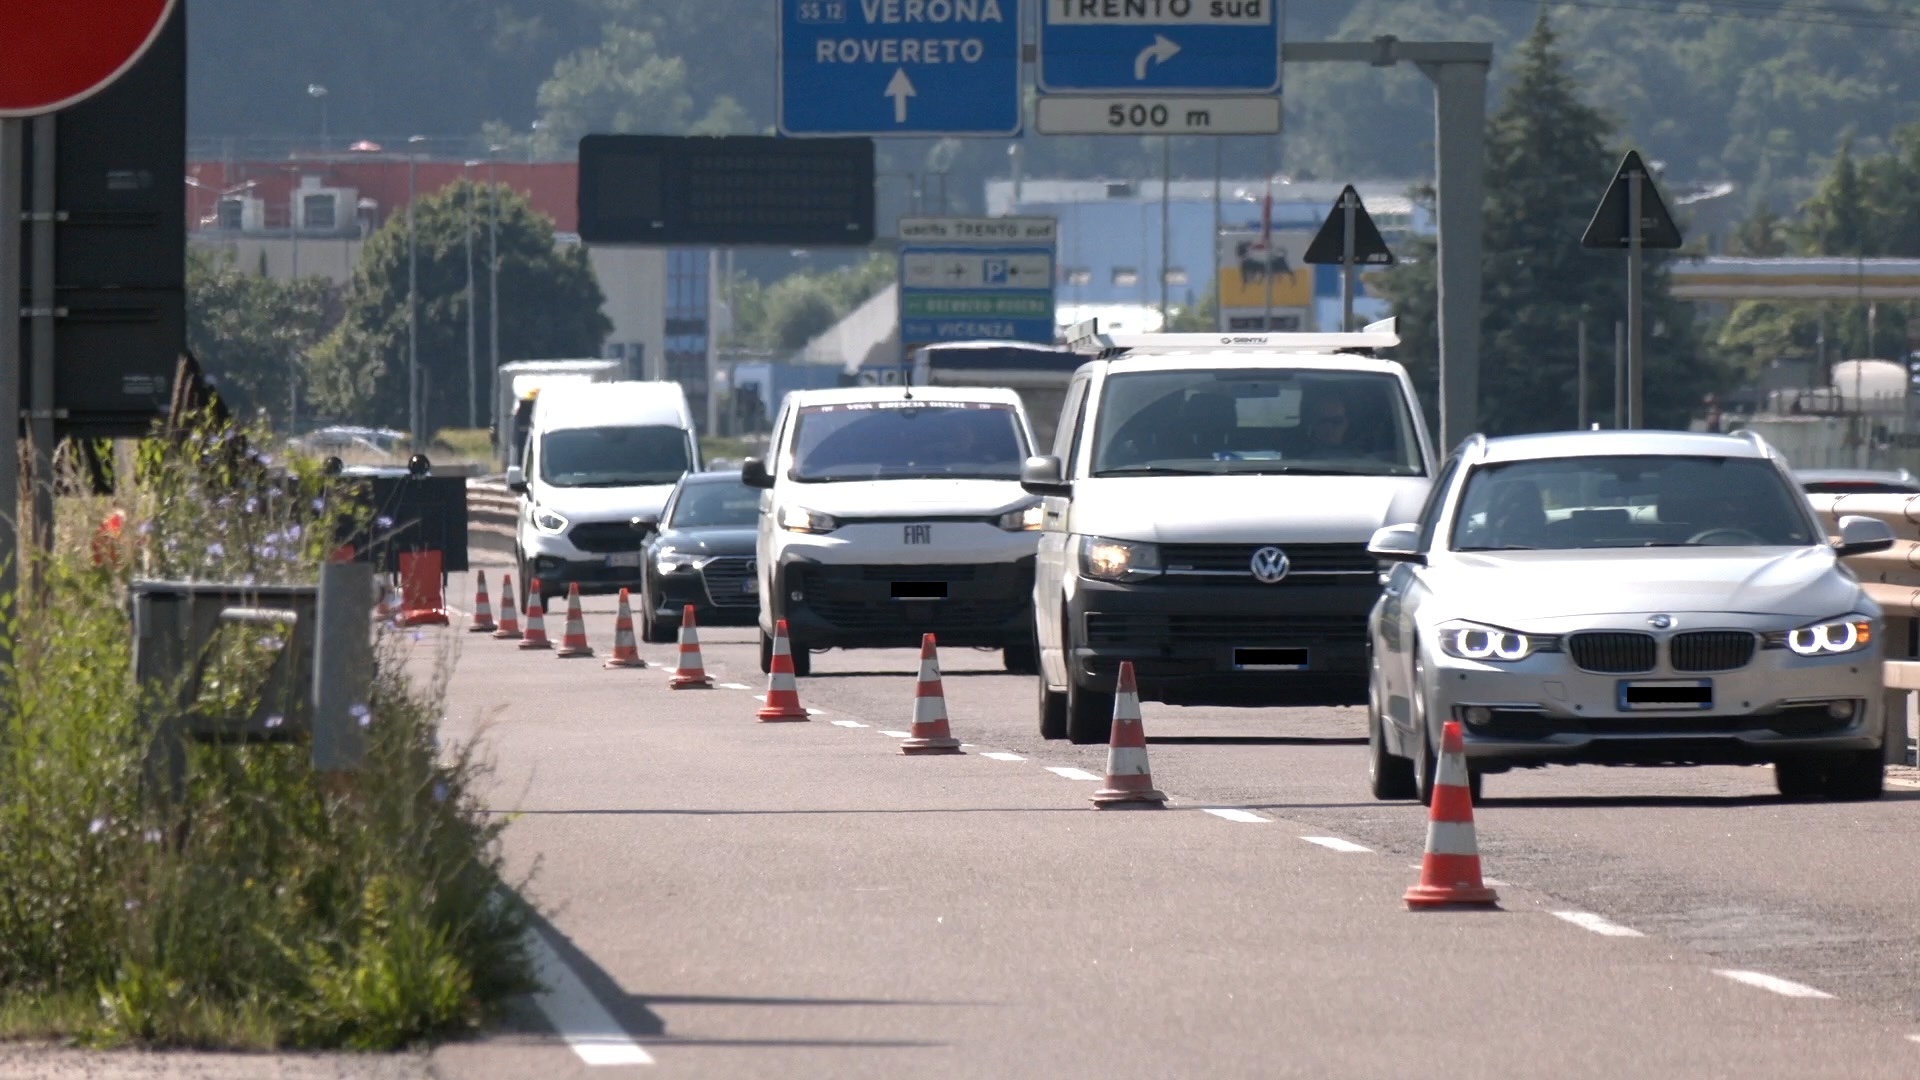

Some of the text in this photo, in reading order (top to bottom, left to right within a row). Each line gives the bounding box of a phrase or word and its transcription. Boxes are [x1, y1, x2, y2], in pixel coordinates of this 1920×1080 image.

[800, 3, 842, 20] SS 12
[861, 0, 1003, 23] VERONA
[1057, 0, 1262, 18] TRENTO sud
[815, 39, 985, 64] ROVERETO
[1108, 104, 1211, 127] 500 m
[954, 223, 1018, 238] TRENTO
[936, 322, 1015, 337] VICENZA
[903, 524, 932, 546] FIAT
